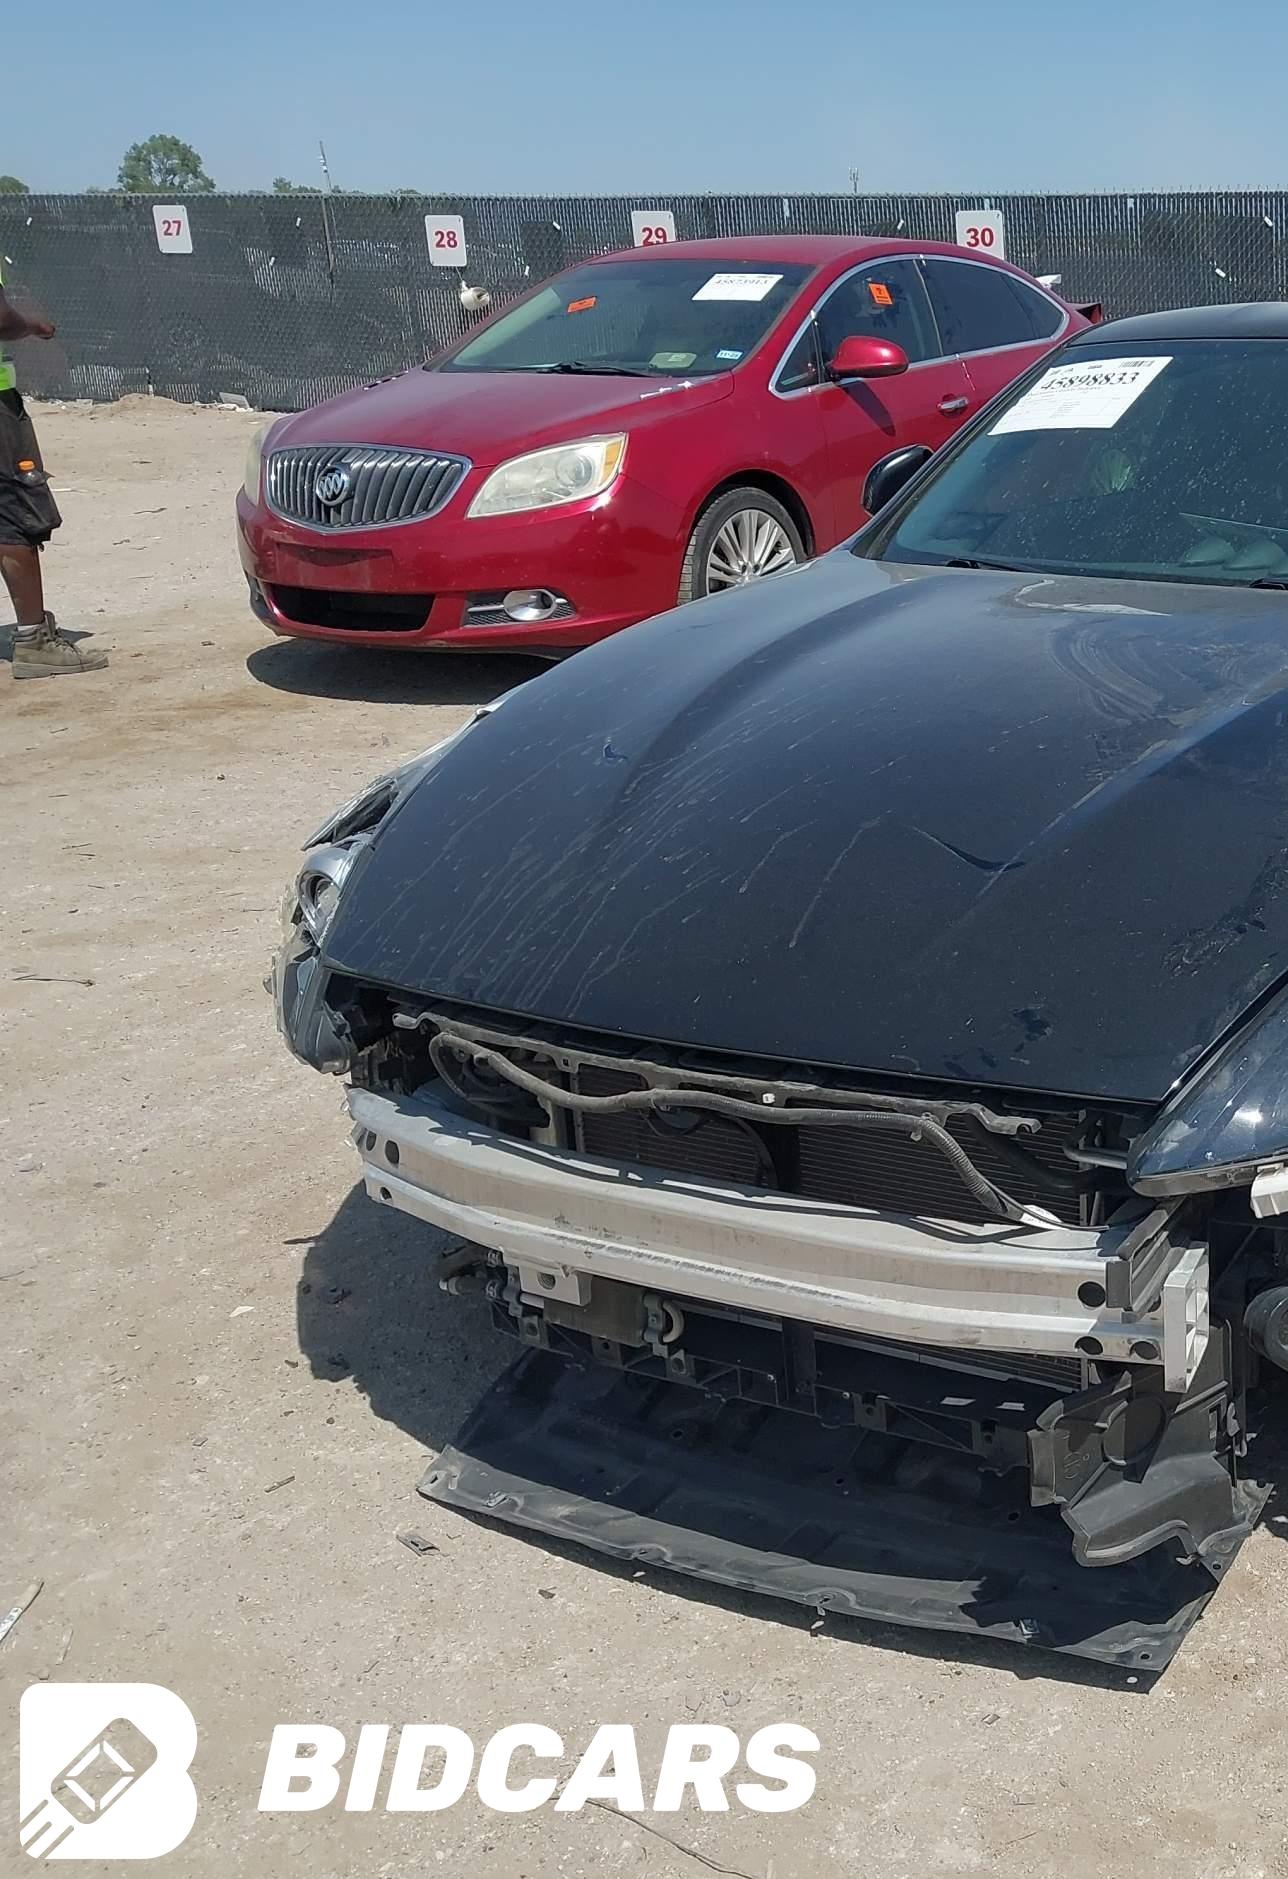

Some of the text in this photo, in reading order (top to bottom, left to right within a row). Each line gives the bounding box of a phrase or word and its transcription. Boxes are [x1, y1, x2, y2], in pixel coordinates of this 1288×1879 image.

[162, 219, 182, 236] 27
[641, 226, 668, 247] 29
[434, 230, 458, 248] 28
[966, 227, 994, 248] 30
[1040, 371, 1140, 390] 45898833
